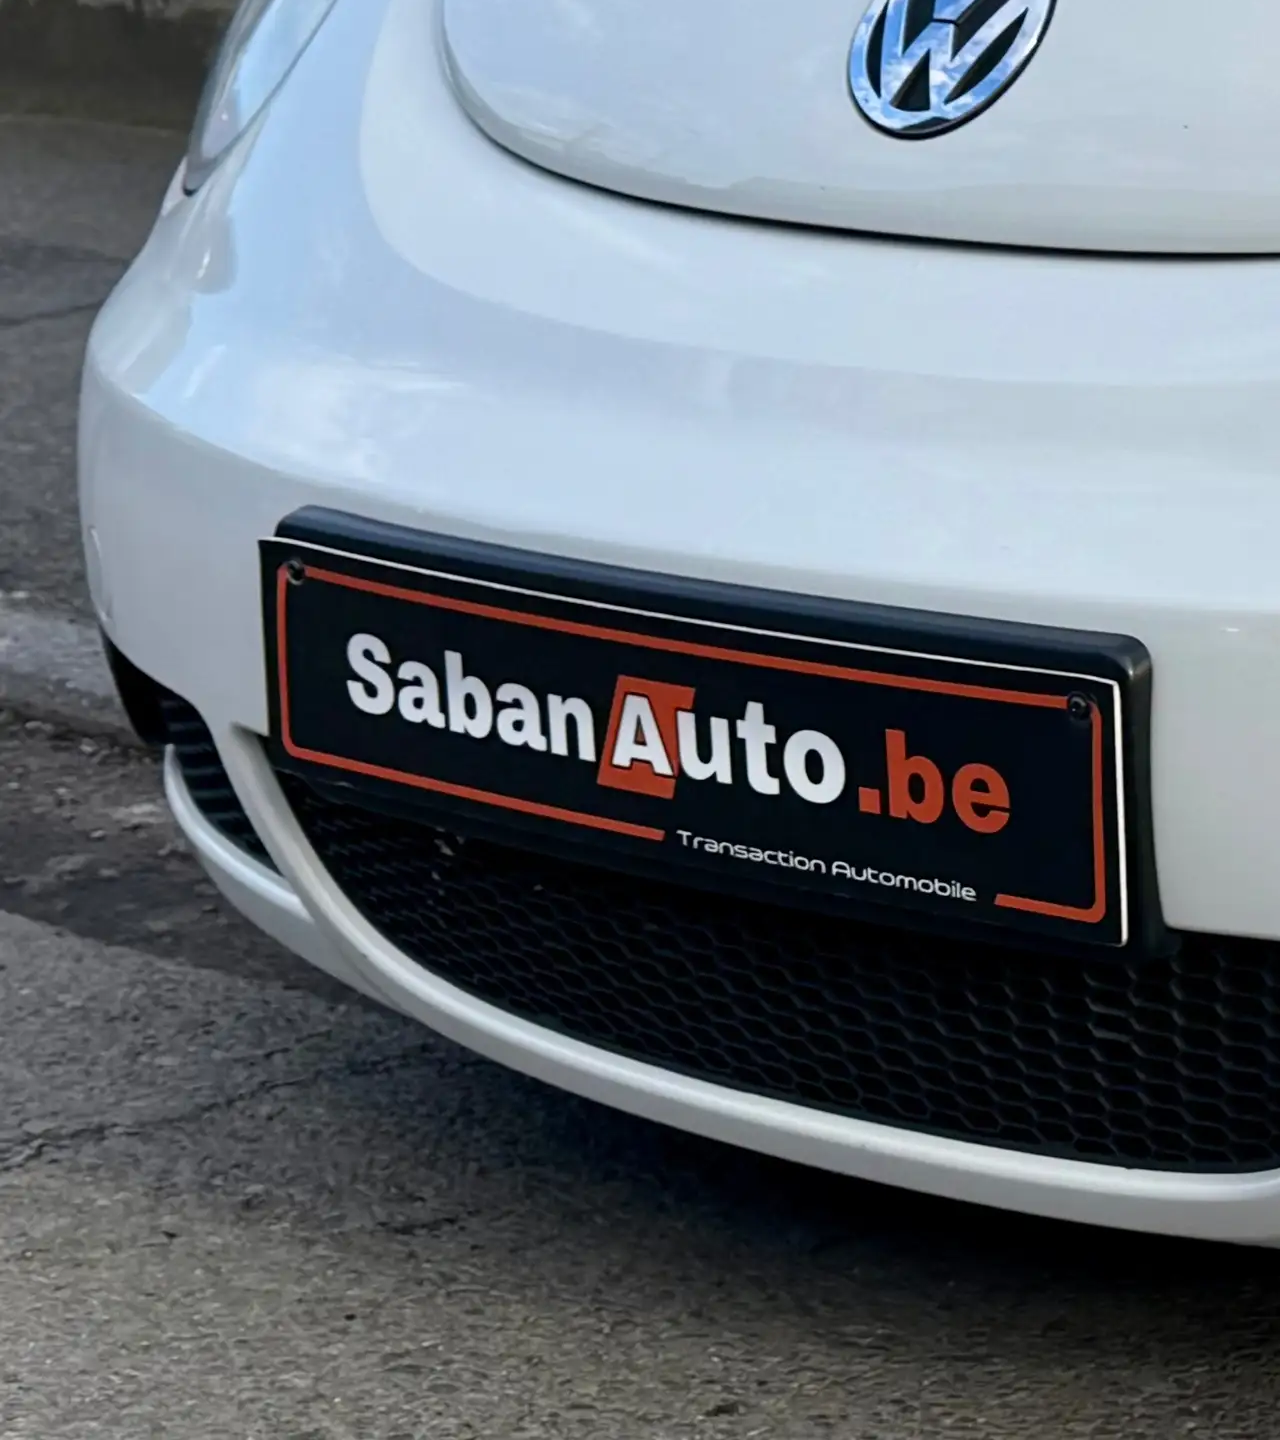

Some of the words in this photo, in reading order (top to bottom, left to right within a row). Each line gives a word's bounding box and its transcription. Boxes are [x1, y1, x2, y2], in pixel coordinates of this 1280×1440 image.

[346, 632, 1011, 833] SabanAuto.be
[676, 829, 827, 875] Transaction
[831, 859, 979, 902] Automobile
